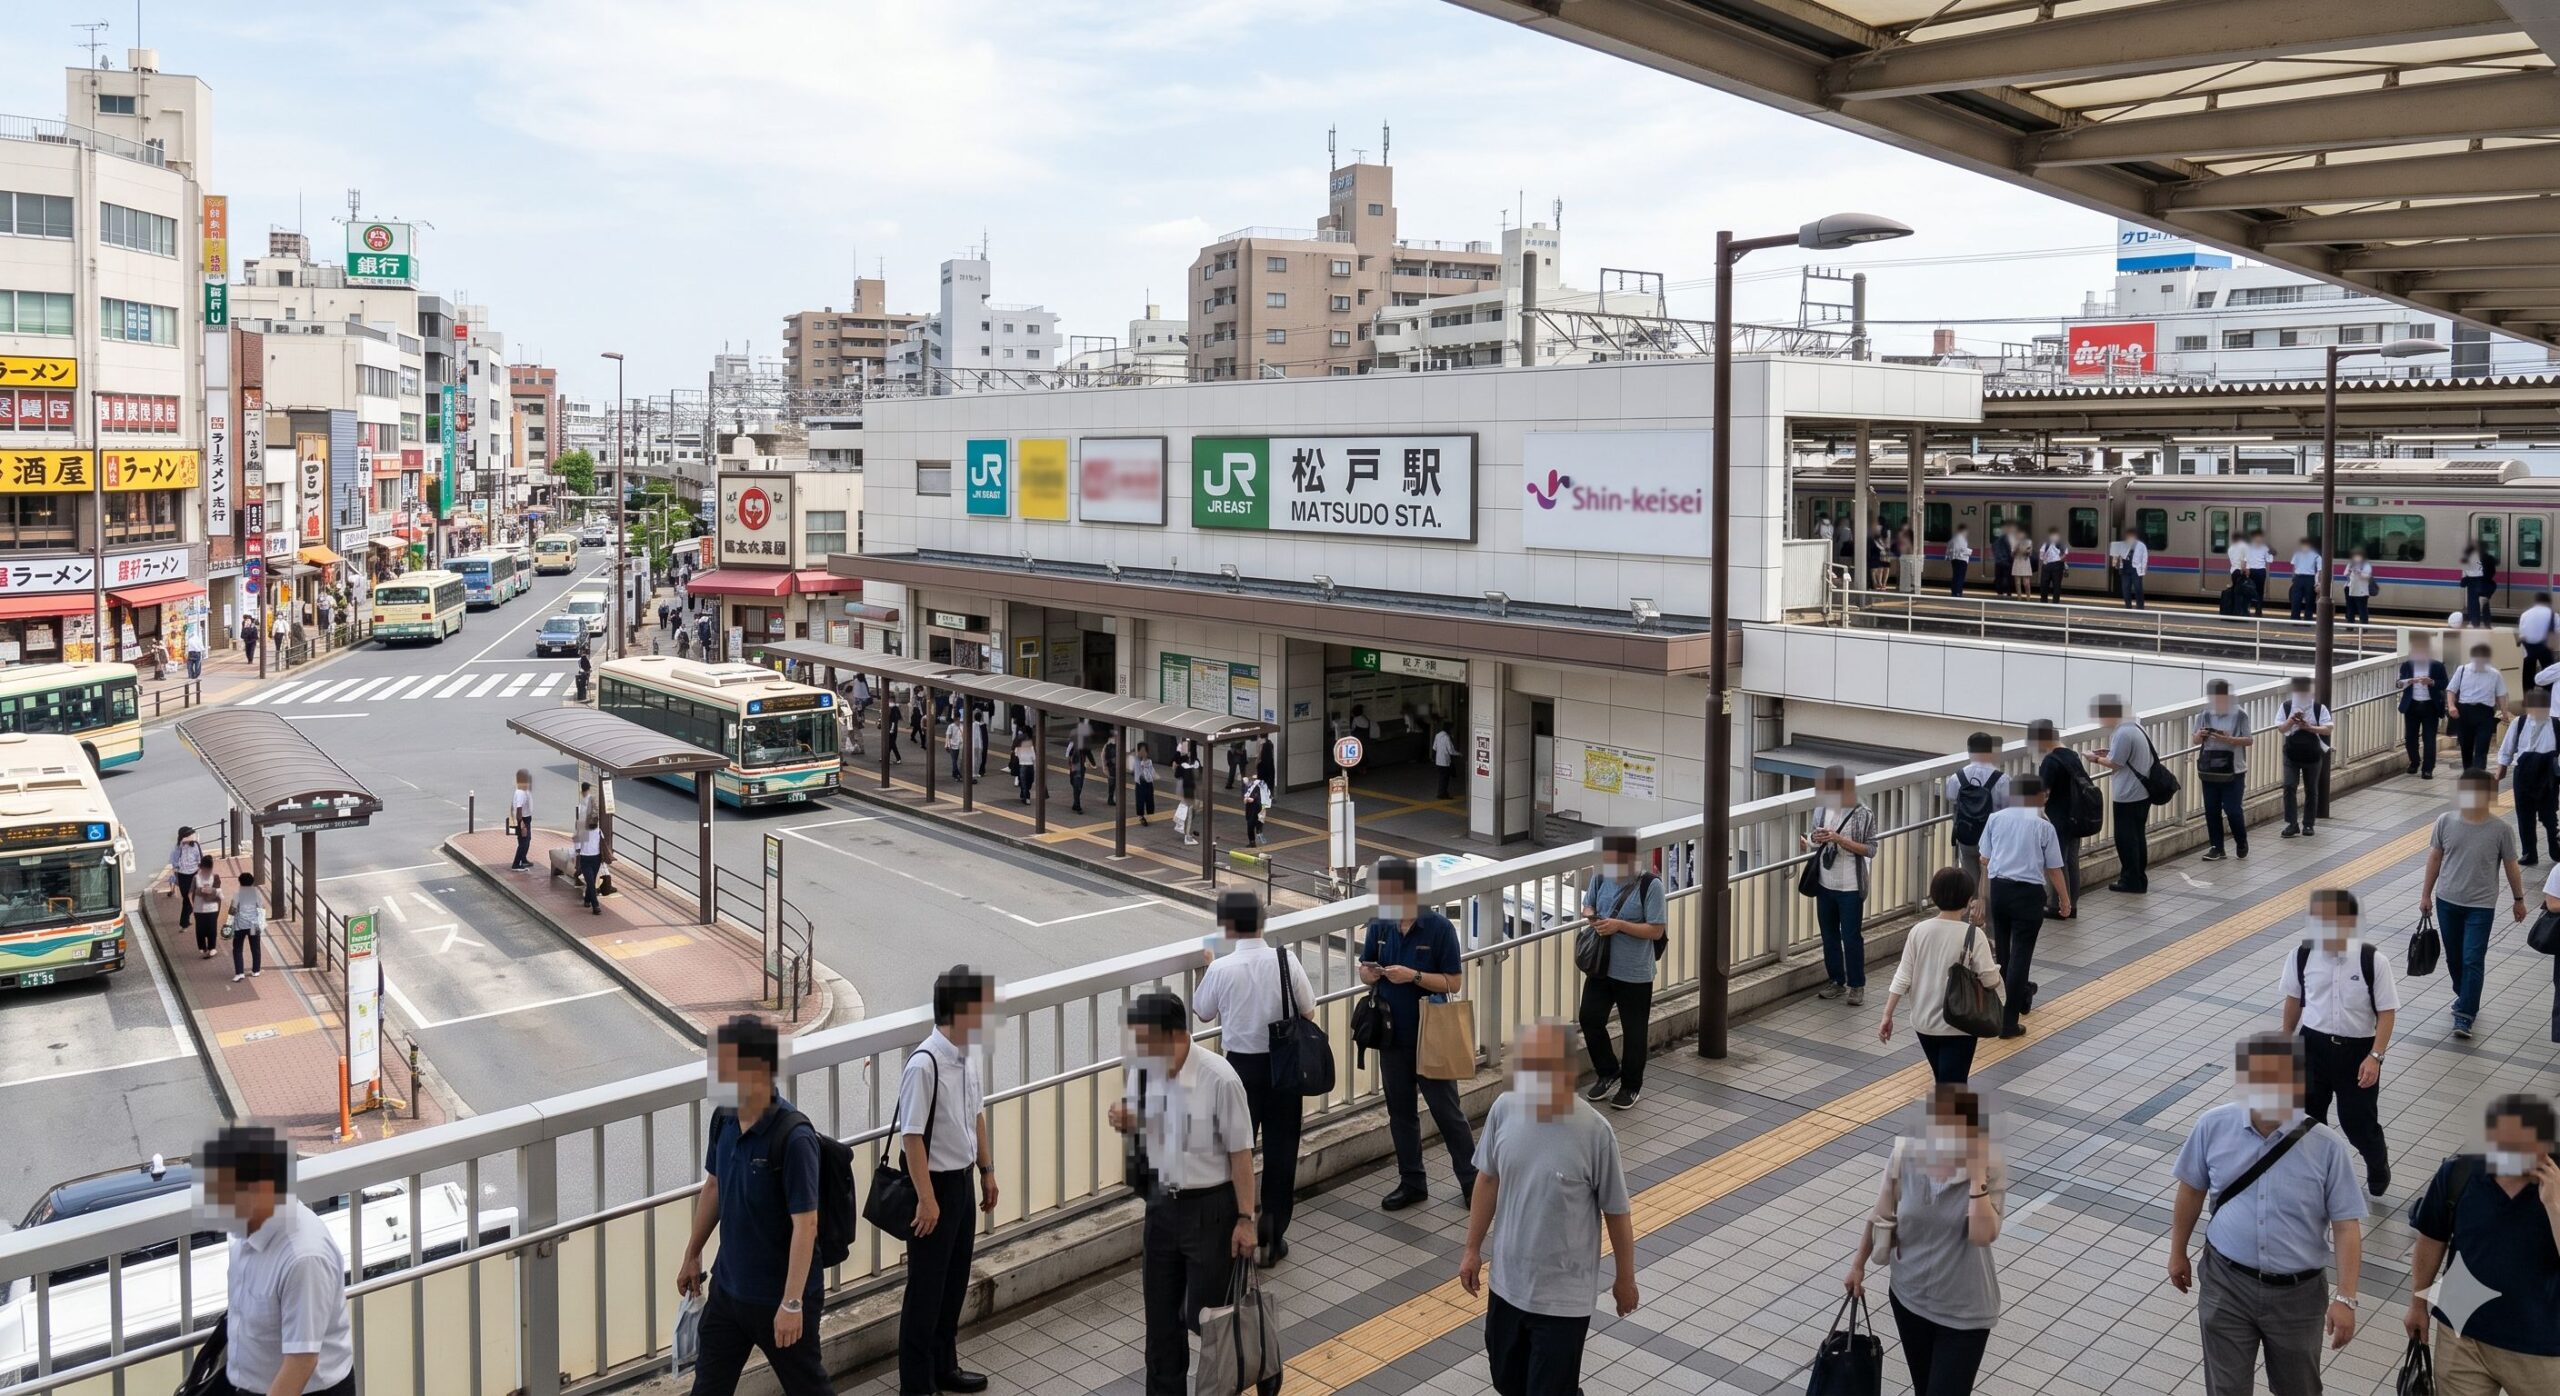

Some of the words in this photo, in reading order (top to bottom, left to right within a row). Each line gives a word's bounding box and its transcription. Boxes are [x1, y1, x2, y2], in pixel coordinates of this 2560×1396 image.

[357, 256, 400, 275] 銀行
[0, 456, 86, 486] 酒屋
[124, 456, 178, 483] ラーメン
[971, 453, 1003, 487] JR
[1203, 452, 1257, 498] JR
[1292, 447, 1442, 497] 松戸駅
[1207, 500, 1222, 513] JR
[1223, 500, 1253, 514] EAST
[1571, 486, 1703, 514] Shin-keisei
[1960, 505, 1977, 516] JR
[1291, 501, 1389, 526] MATSUDO
[1395, 504, 1442, 529] STA.
[2176, 511, 2196, 522] JR
[12, 565, 93, 588] ラーメン
[142, 556, 179, 578] ラーメン
[1363, 653, 1376, 665] JR
